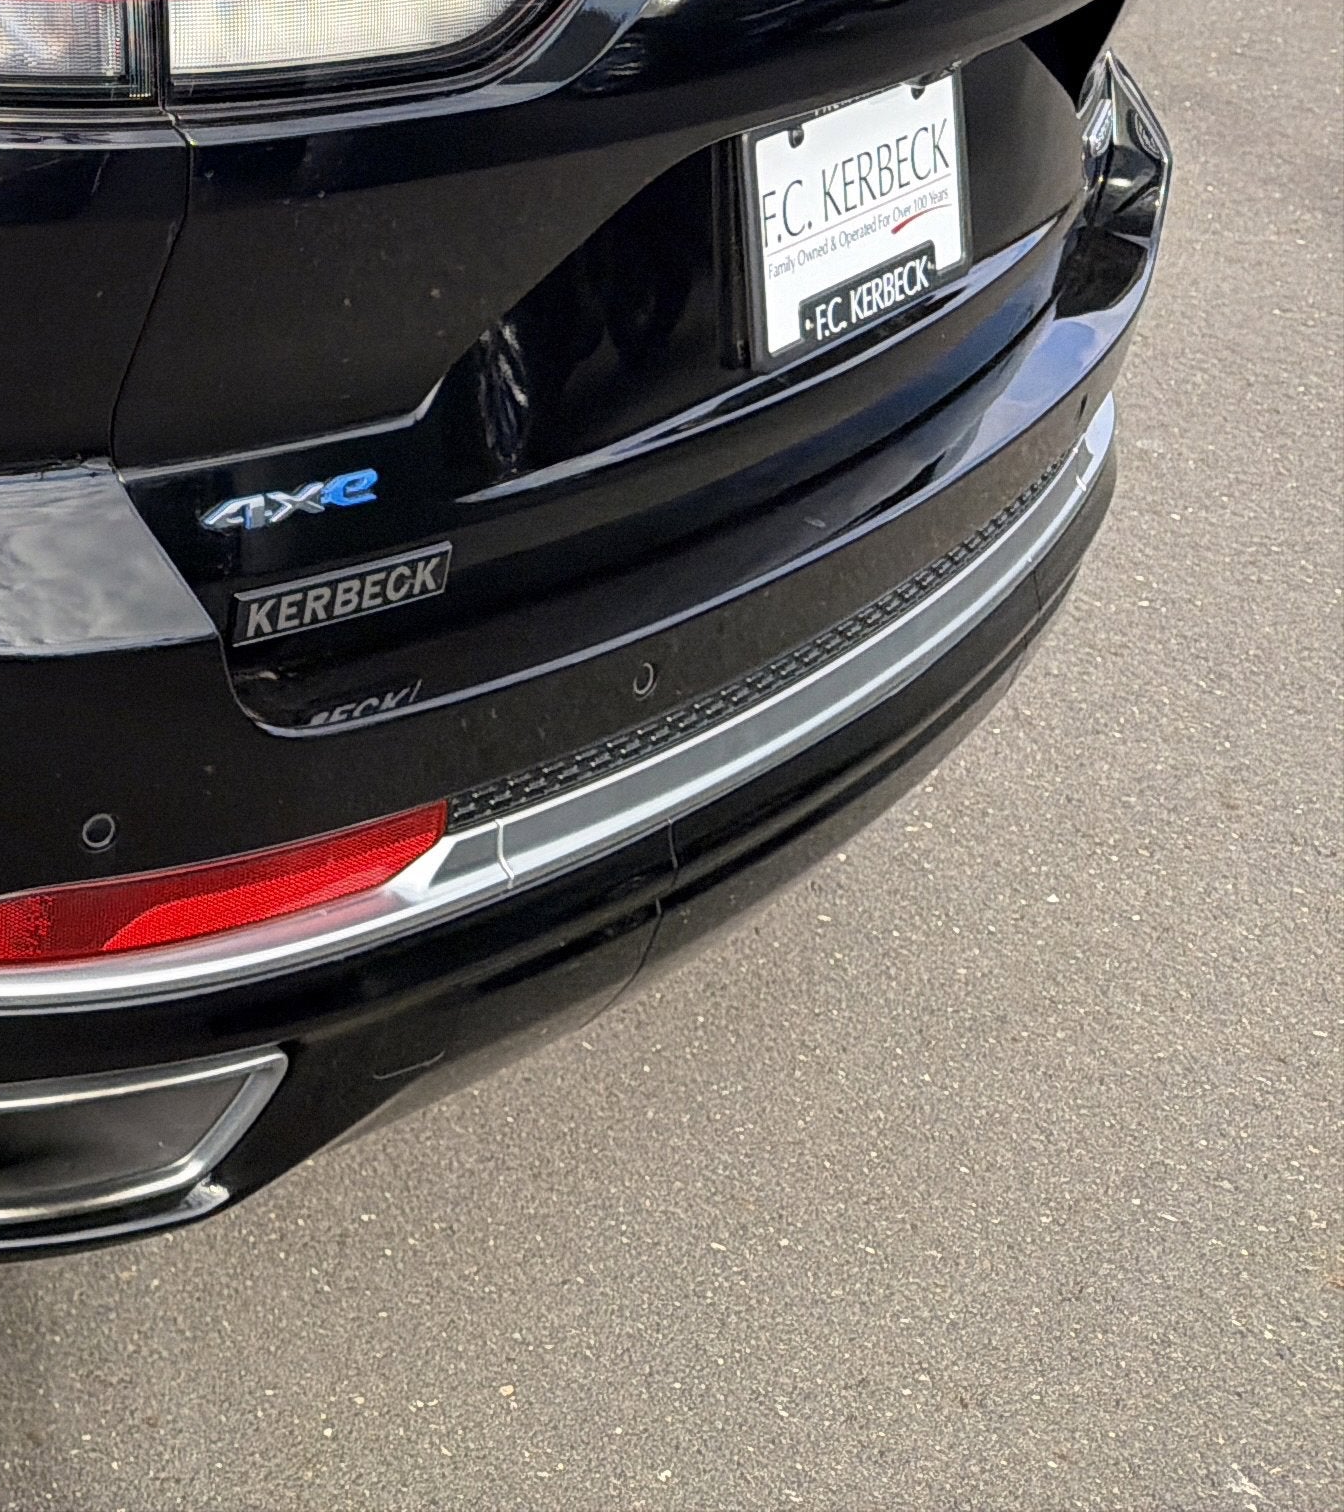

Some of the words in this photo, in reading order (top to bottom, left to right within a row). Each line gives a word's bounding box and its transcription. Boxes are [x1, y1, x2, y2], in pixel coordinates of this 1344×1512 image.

[762, 179, 813, 248] F.C.
[822, 118, 950, 222] KERBECK
[768, 256, 795, 280] Family
[797, 244, 829, 266] Owned
[830, 238, 837, 252] &
[838, 216, 877, 248] Operated
[878, 212, 891, 231] For
[892, 206, 912, 222] Over
[913, 195, 928, 212] 100
[929, 188, 949, 205] Years
[815, 297, 848, 341] F.C.
[850, 254, 931, 325] KERBECK
[246, 556, 442, 639] KERBECK
